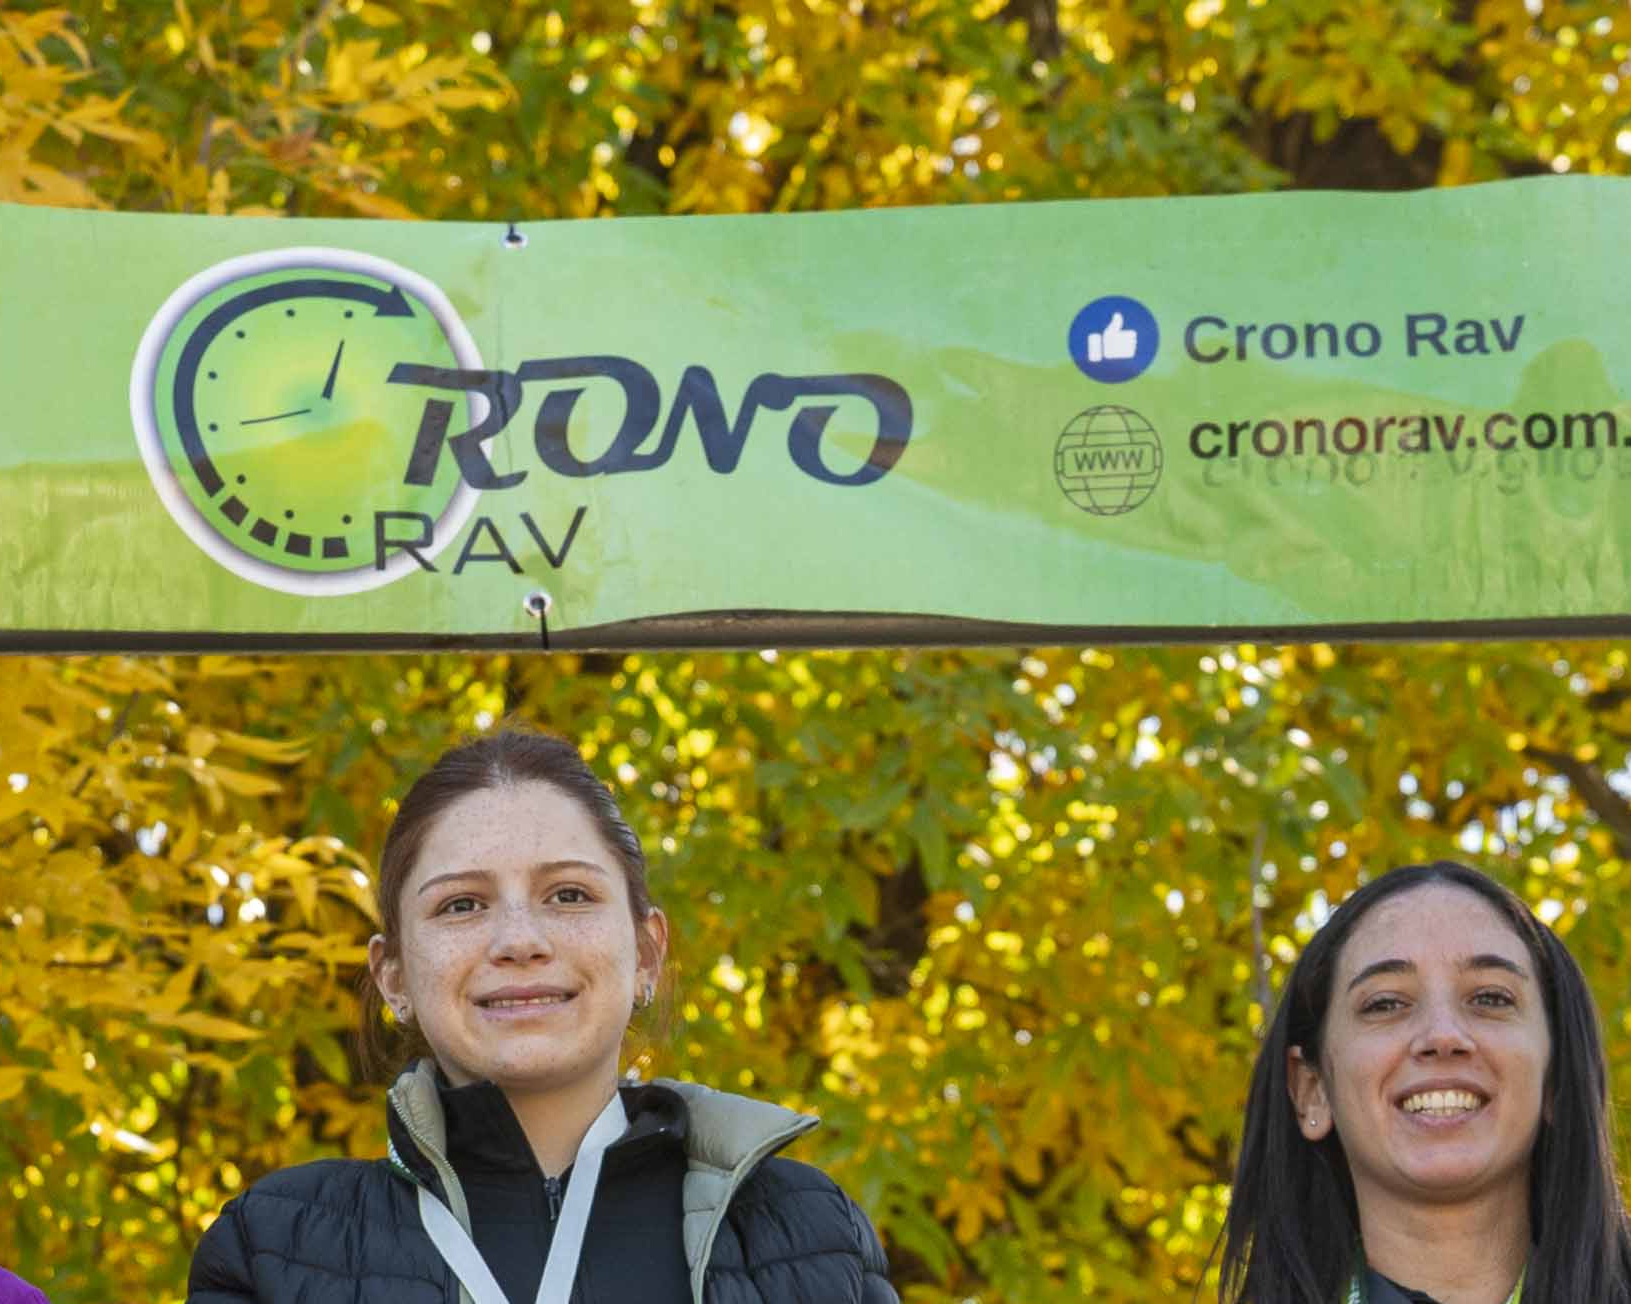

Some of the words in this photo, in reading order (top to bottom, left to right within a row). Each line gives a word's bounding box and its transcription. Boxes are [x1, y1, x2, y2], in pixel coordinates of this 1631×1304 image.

[1182, 314, 1383, 364] Crono
[1405, 310, 1526, 358] Rav
[374, 506, 588, 576] RAV
